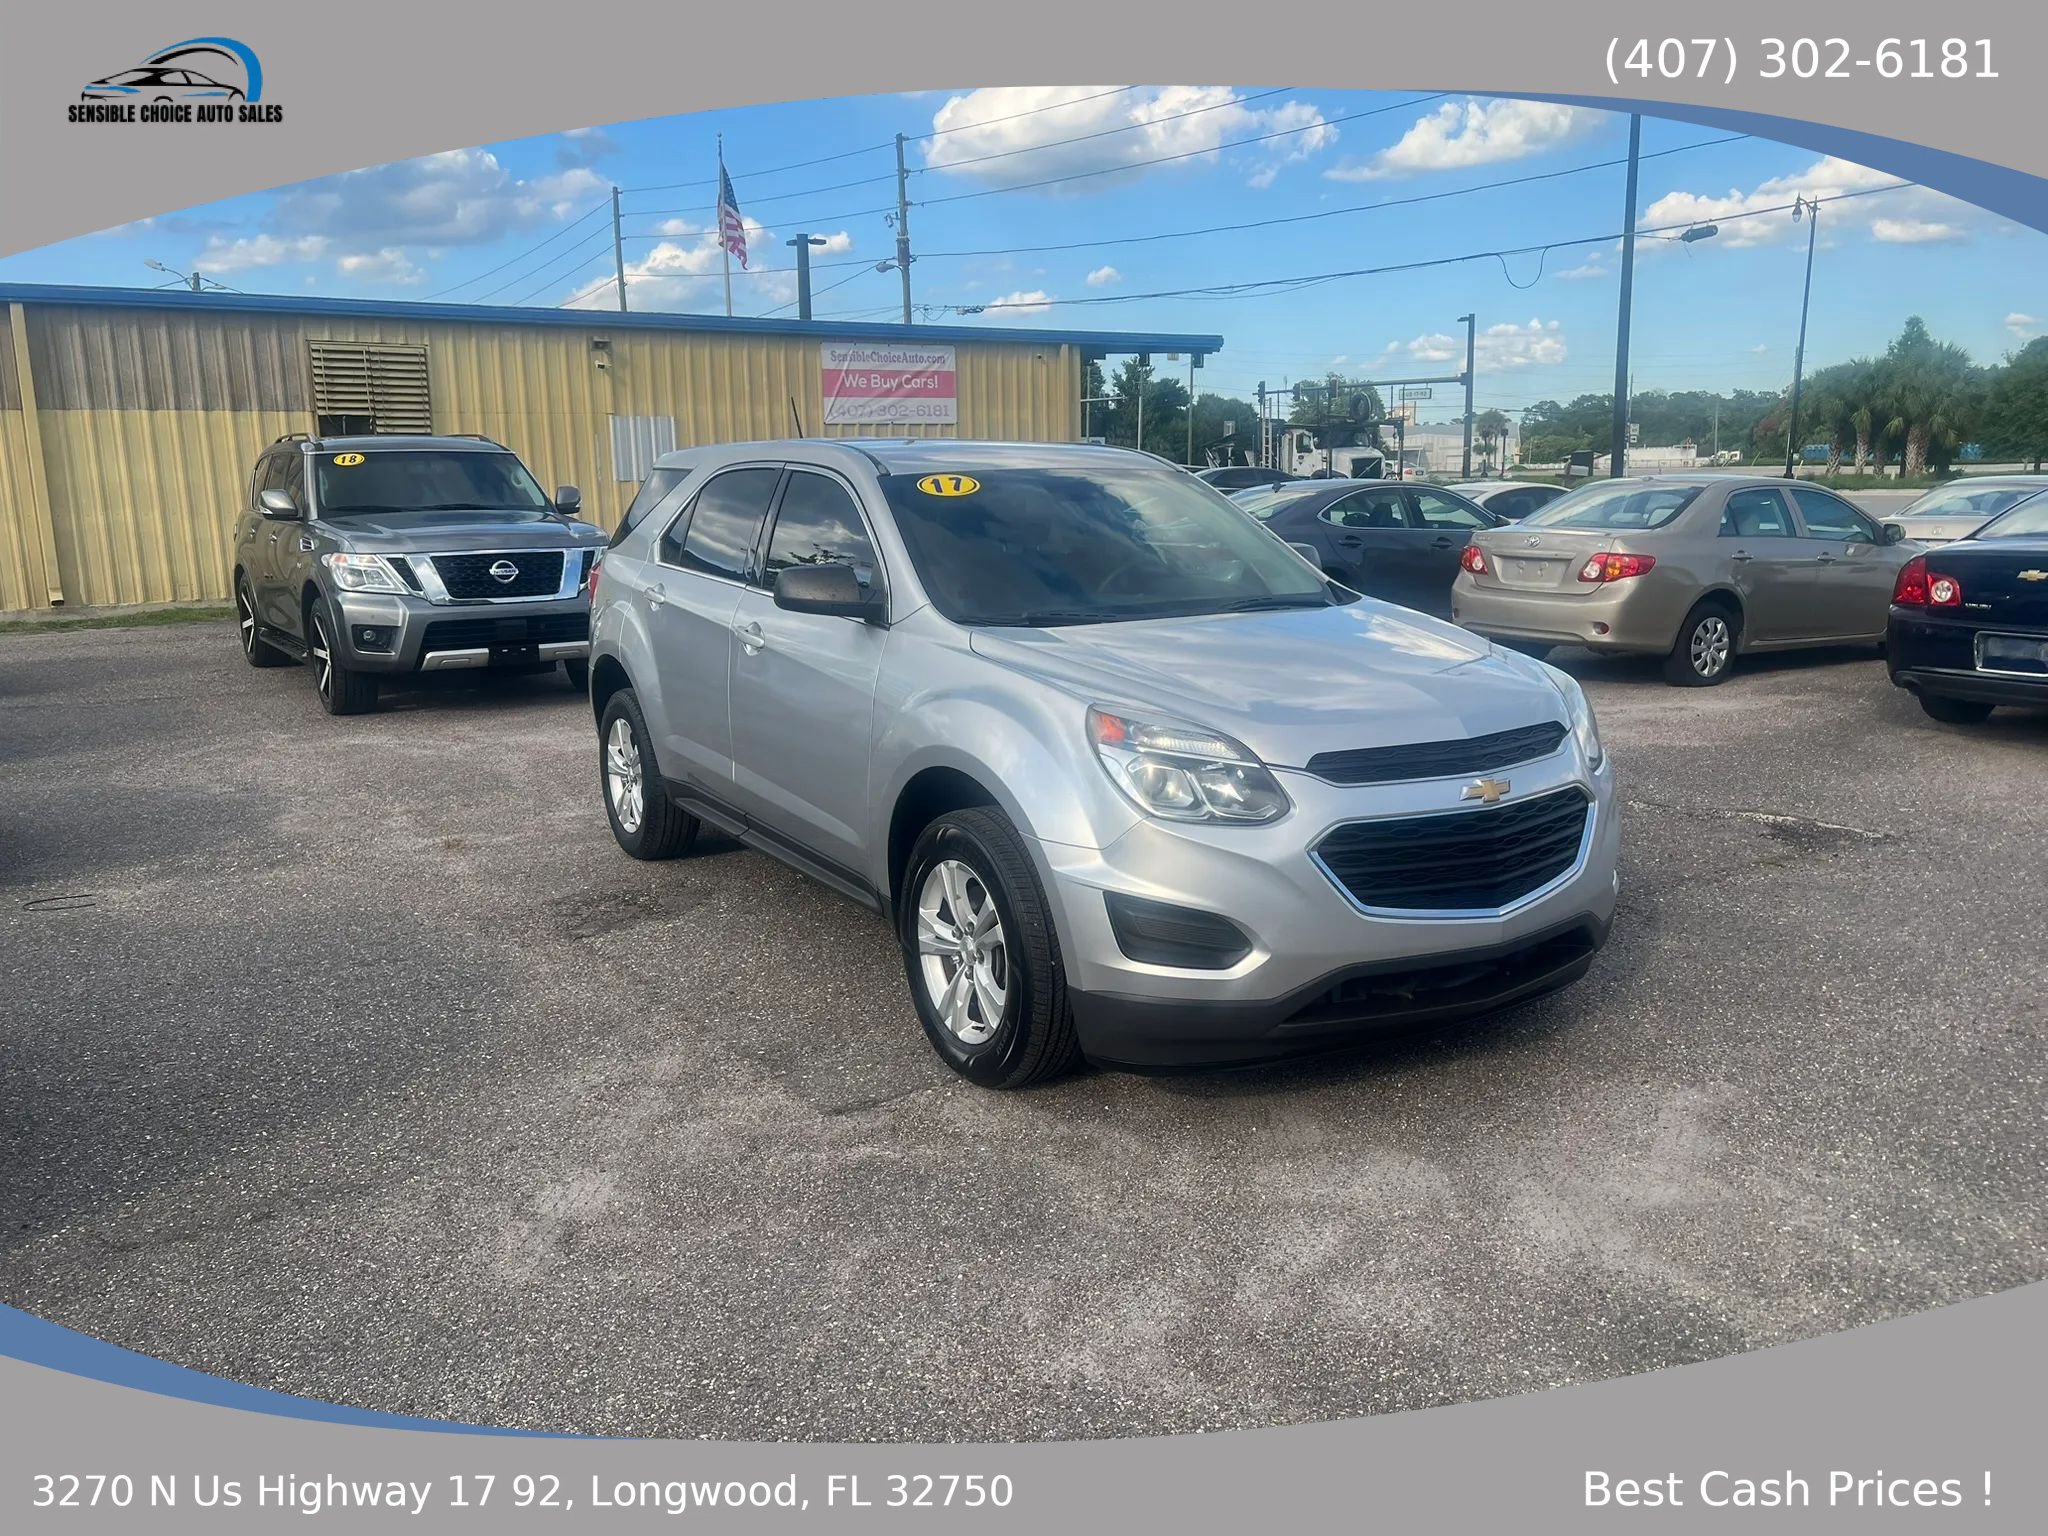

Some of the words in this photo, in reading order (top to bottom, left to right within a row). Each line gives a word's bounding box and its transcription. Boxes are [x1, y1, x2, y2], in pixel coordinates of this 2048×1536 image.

[830, 350, 946, 364] SensibleChoiceAuto.com
[843, 374, 867, 388] We
[870, 374, 899, 391] Buy
[901, 375, 938, 389] Cars!
[341, 455, 357, 464] 18
[930, 476, 962, 494] 17
